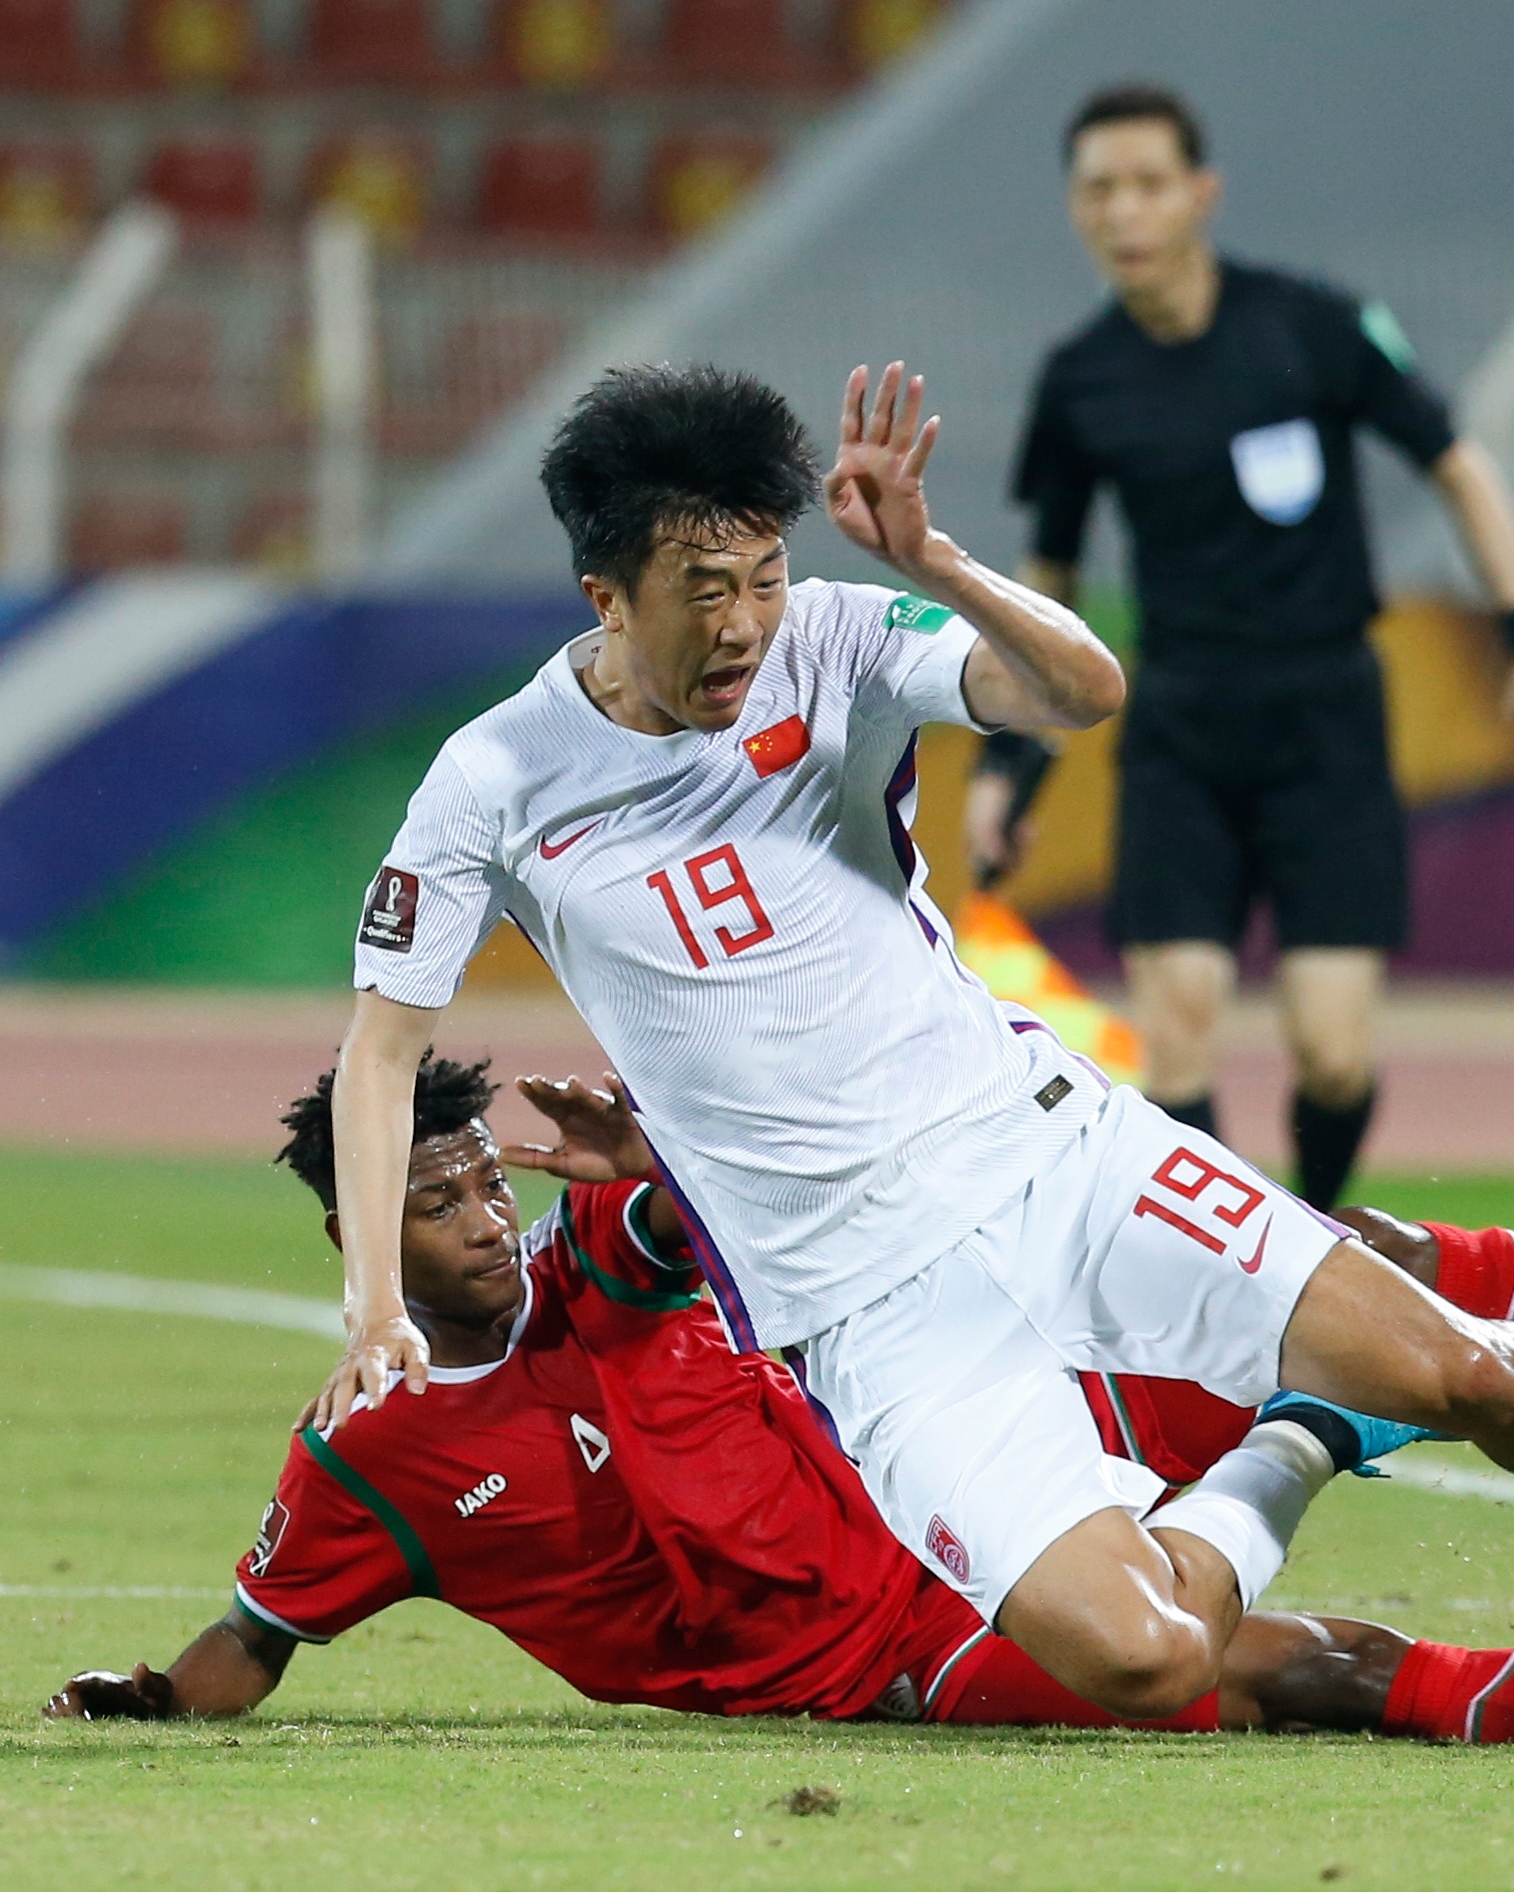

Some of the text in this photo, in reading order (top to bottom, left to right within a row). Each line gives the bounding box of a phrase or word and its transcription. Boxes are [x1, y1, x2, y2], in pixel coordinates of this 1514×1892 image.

[646, 842, 775, 970] 19
[1133, 1146, 1266, 1256] 19
[454, 1473, 507, 1518] JAKO
